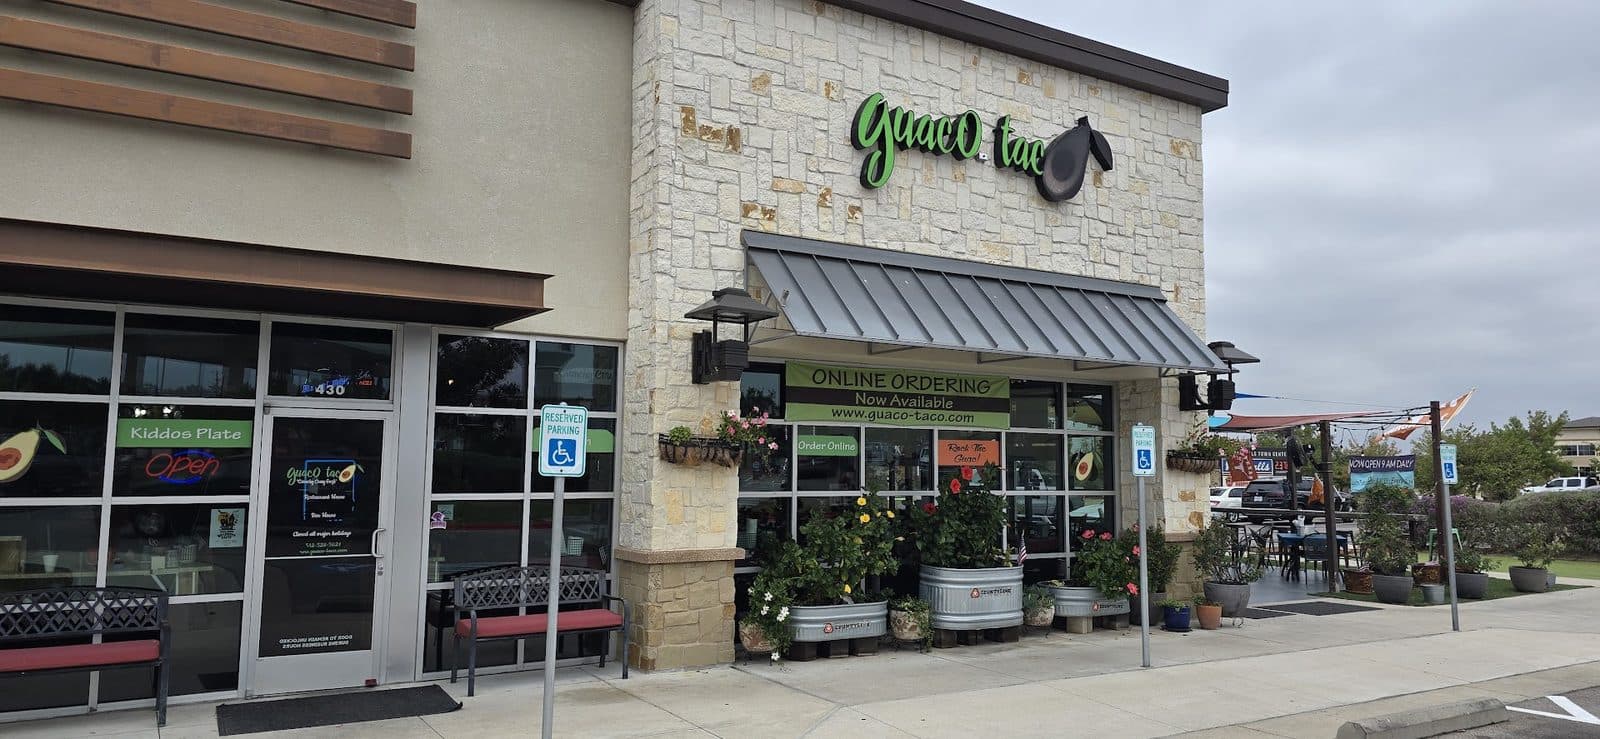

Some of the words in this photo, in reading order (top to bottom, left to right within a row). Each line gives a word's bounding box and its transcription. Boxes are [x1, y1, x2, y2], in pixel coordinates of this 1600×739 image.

[812, 368, 887, 388] ONLINE
[891, 374, 991, 395] ORDERING
[315, 384, 345, 395] 430
[855, 392, 888, 406] Now
[889, 395, 954, 409] Available
[545, 412, 584, 424] RESERVED
[831, 407, 975, 424] www.guaco-taco.com
[130, 427, 193, 439] Kiddos
[196, 427, 242, 440] Plate
[547, 425, 580, 435] PARKING
[798, 441, 826, 450] Order
[827, 441, 856, 451] Online
[144, 452, 221, 479] Open
[1365, 459, 1381, 468] OPEN
[1382, 459, 1386, 468] 9
[1386, 459, 1396, 468] AM
